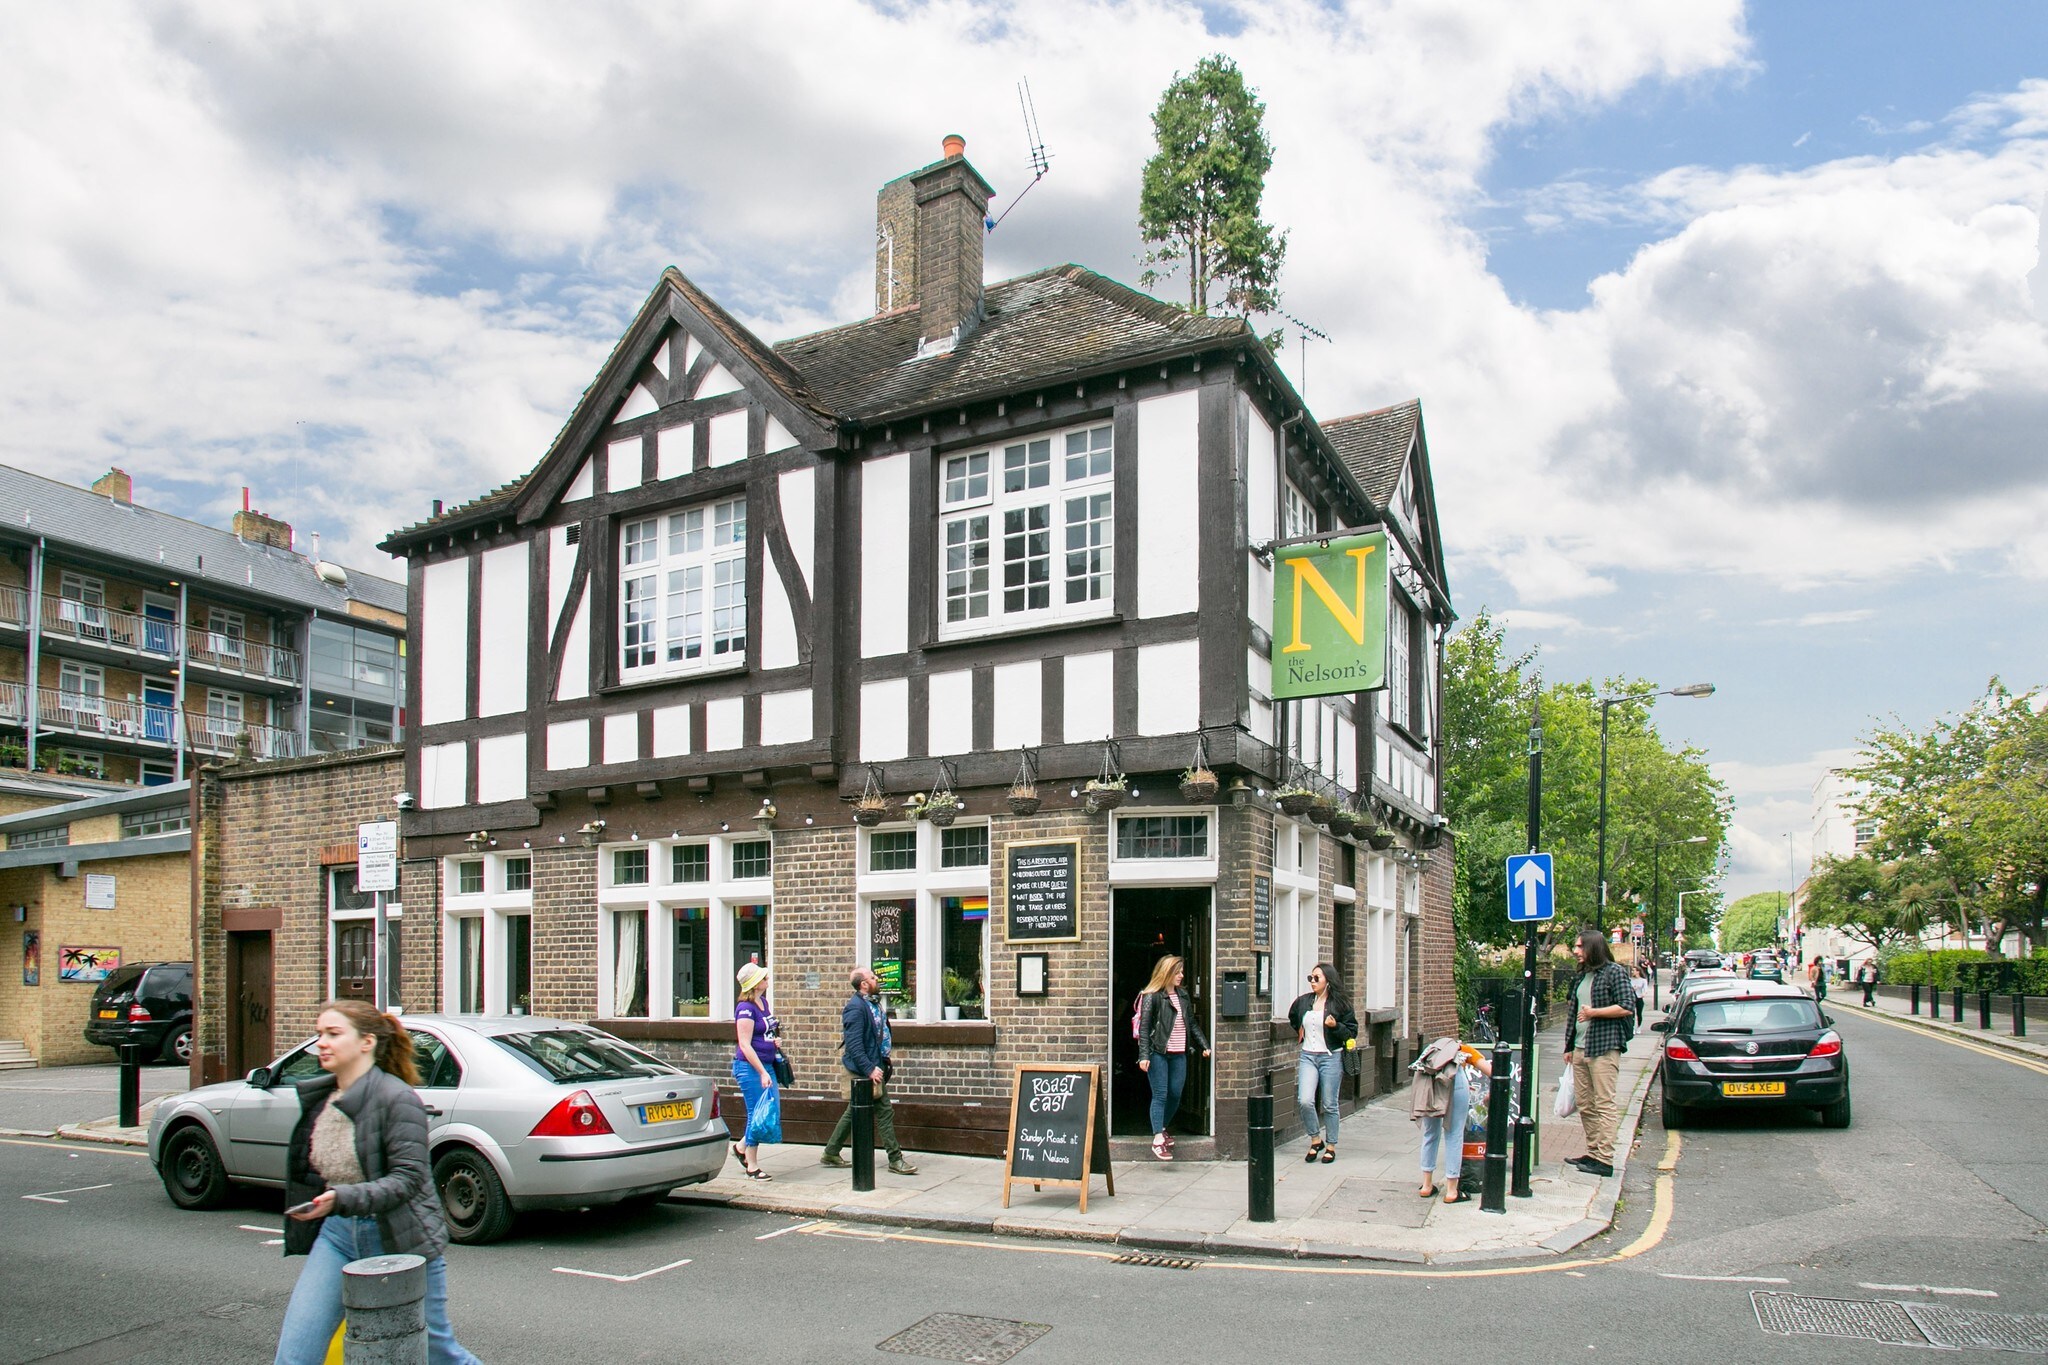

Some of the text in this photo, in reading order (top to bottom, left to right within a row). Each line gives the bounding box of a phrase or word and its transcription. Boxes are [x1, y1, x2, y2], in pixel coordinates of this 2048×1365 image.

[1282, 545, 1376, 654] N
[1287, 656, 1305, 667] the
[1287, 659, 1368, 685] Nelson's
[872, 906, 901, 919] KARAOKE
[873, 932, 899, 944] SUNDAY
[1728, 1083, 1780, 1092] OV54 XEJ
[647, 1103, 693, 1120] RY03 VGP
[1020, 1128, 1078, 1147] Sunday Roast at
[1019, 1147, 1035, 1162] The
